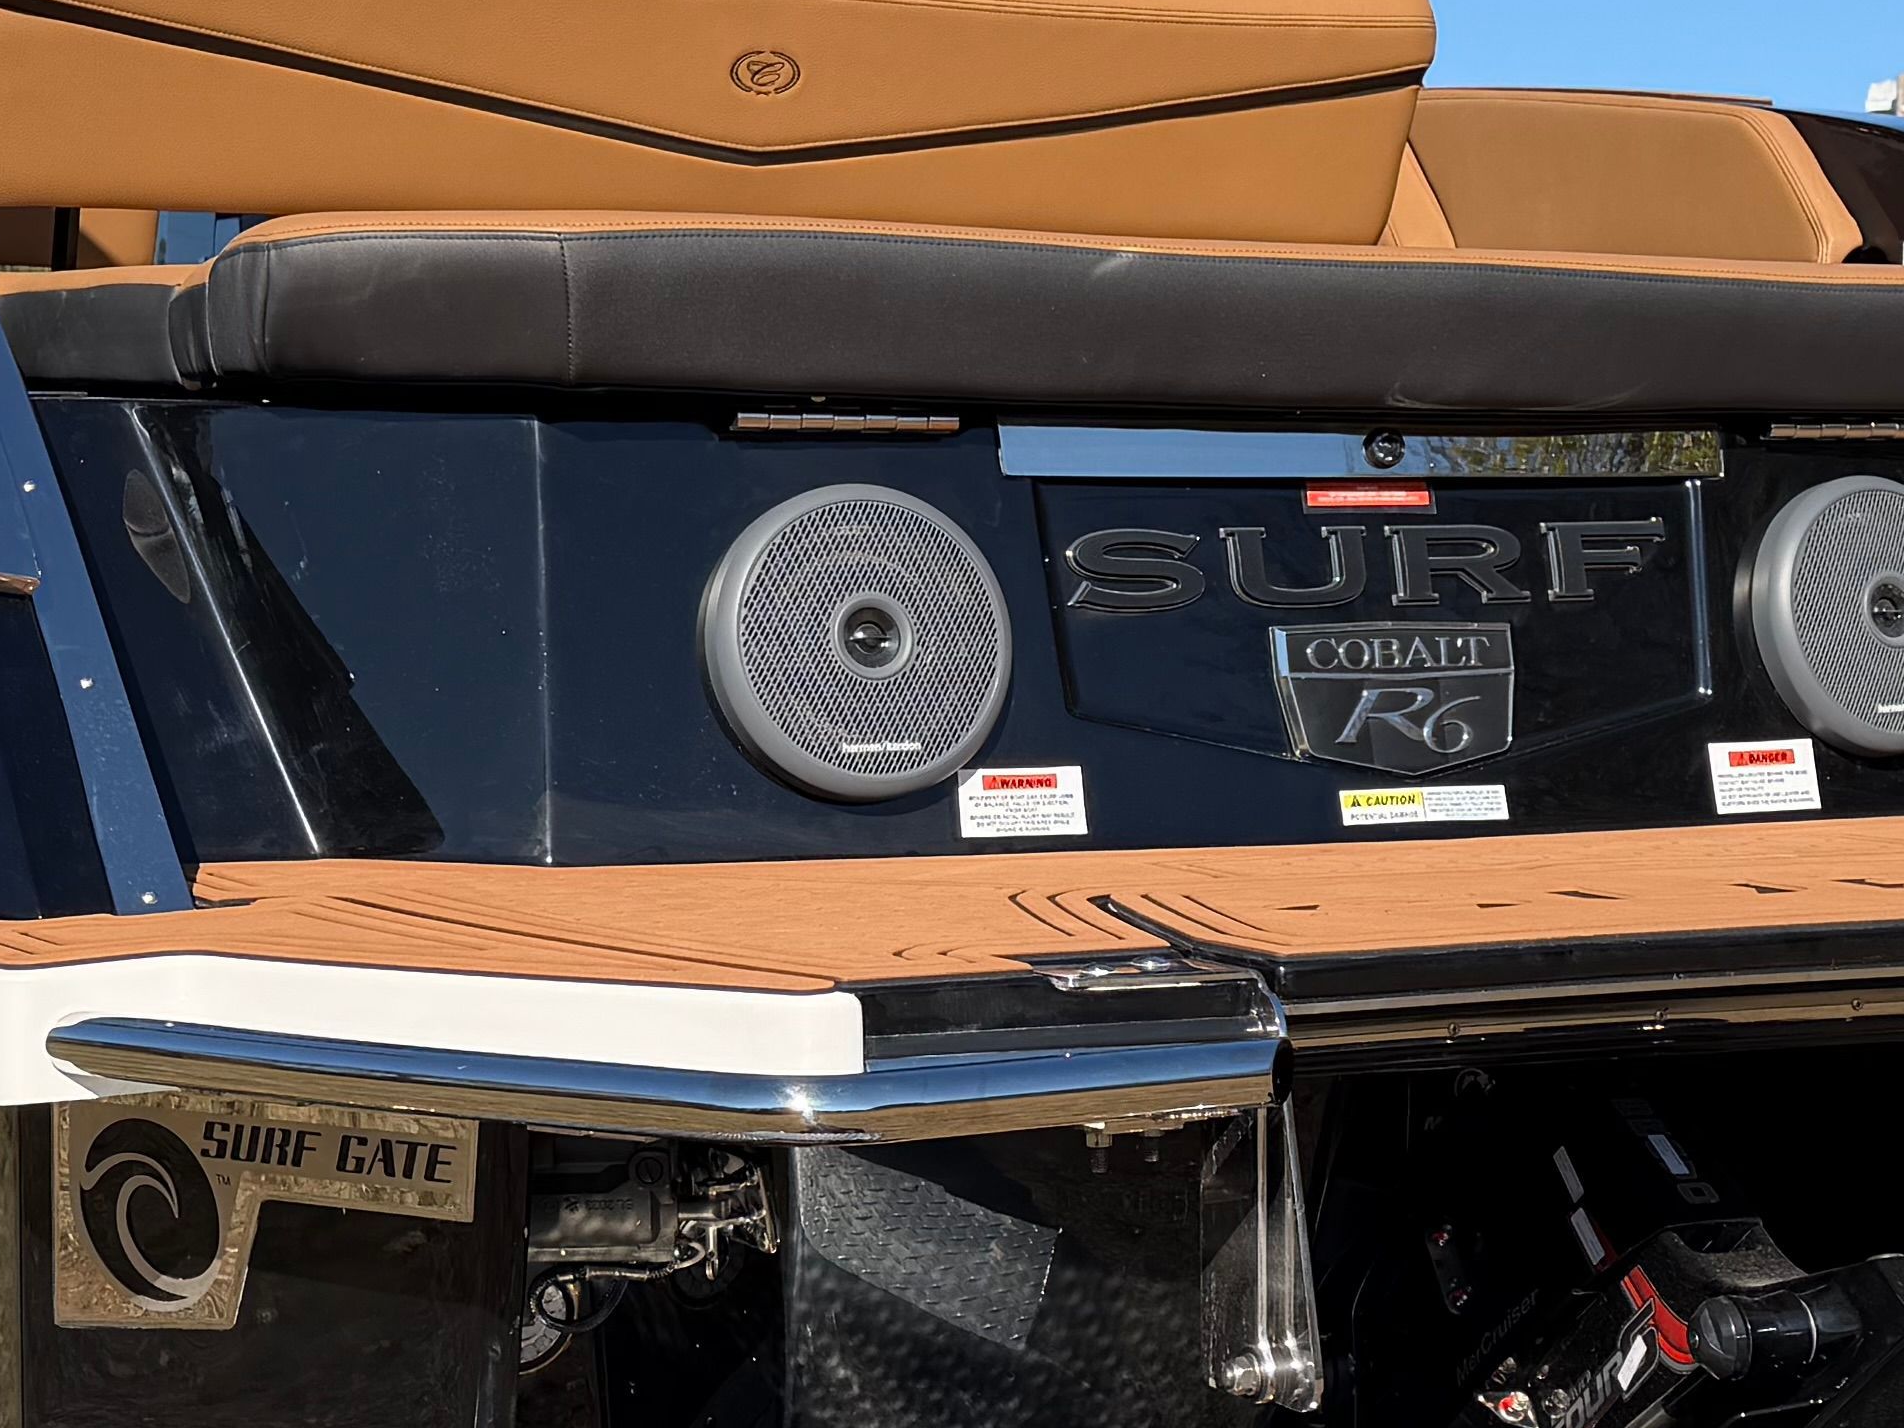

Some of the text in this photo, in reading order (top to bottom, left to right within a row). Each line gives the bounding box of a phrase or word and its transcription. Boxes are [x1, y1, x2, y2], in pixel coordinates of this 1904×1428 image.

[1066, 516, 1666, 613] SURF
[1306, 636, 1491, 670] COBALT
[1334, 685, 1482, 754] R6
[1748, 751, 1788, 765] DANGER
[1000, 777, 1053, 789] WARNING
[1365, 794, 1416, 807] CAUTION
[200, 1120, 458, 1184] SURF GATE
